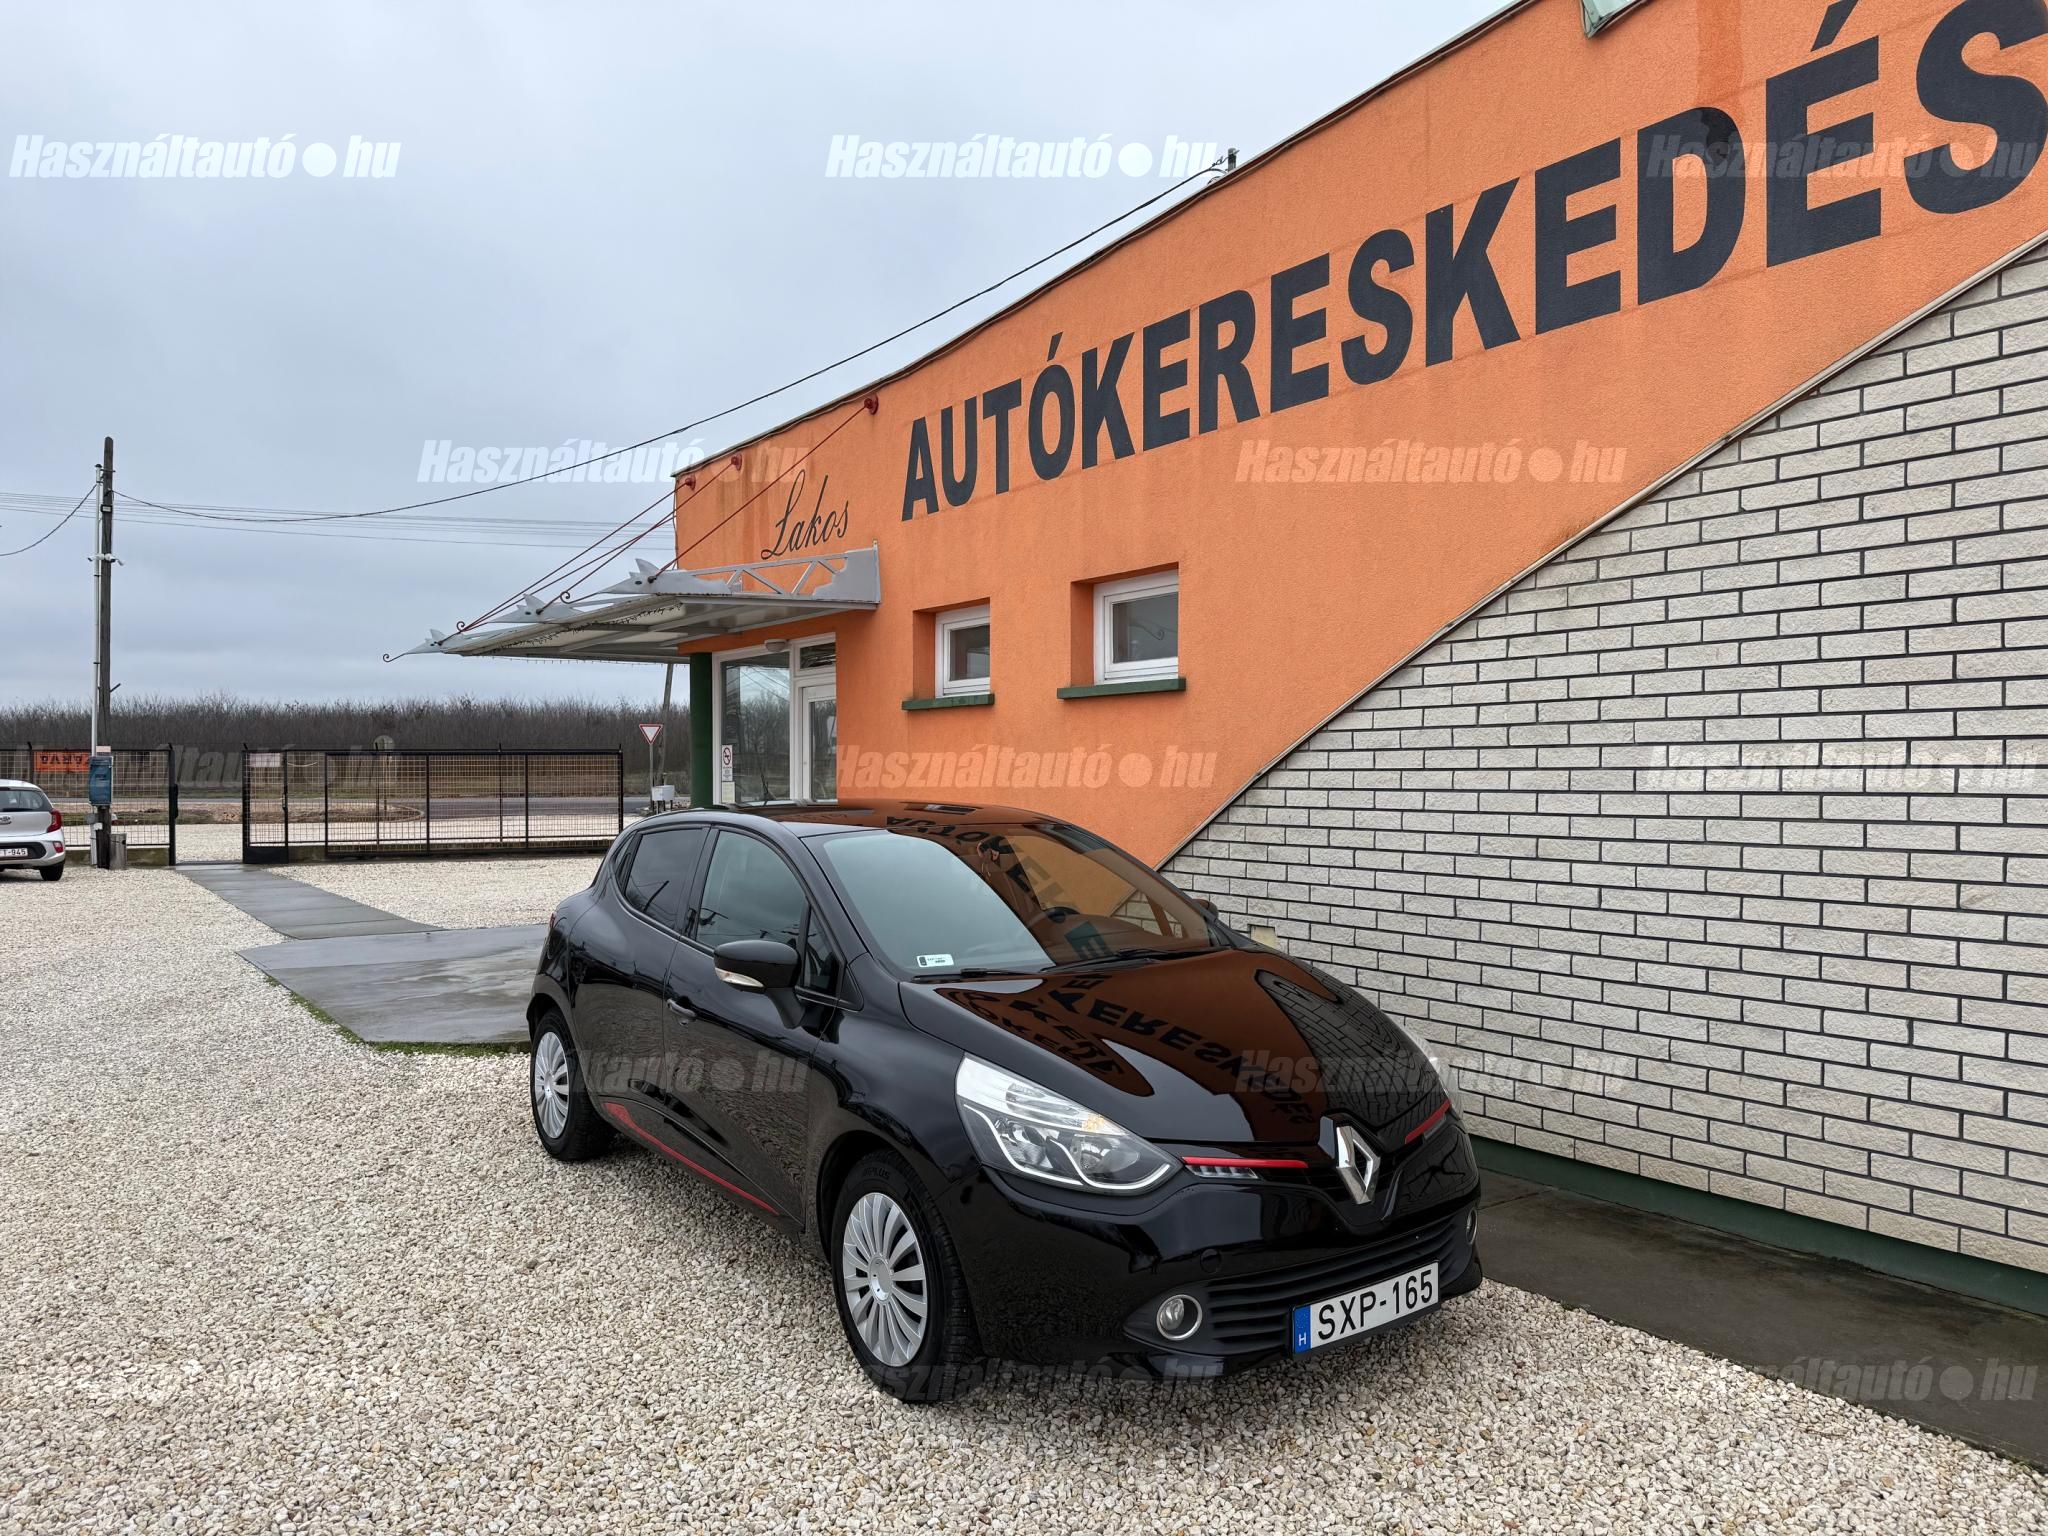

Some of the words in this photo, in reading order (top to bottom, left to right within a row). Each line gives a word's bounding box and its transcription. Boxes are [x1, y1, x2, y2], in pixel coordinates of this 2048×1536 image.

[761, 468, 849, 560] Lakos
[901, 0, 2048, 521] AUTÓKERESKEDÉS
[1298, 1332, 1307, 1347] H
[1317, 1269, 1433, 1341] SXP-165
